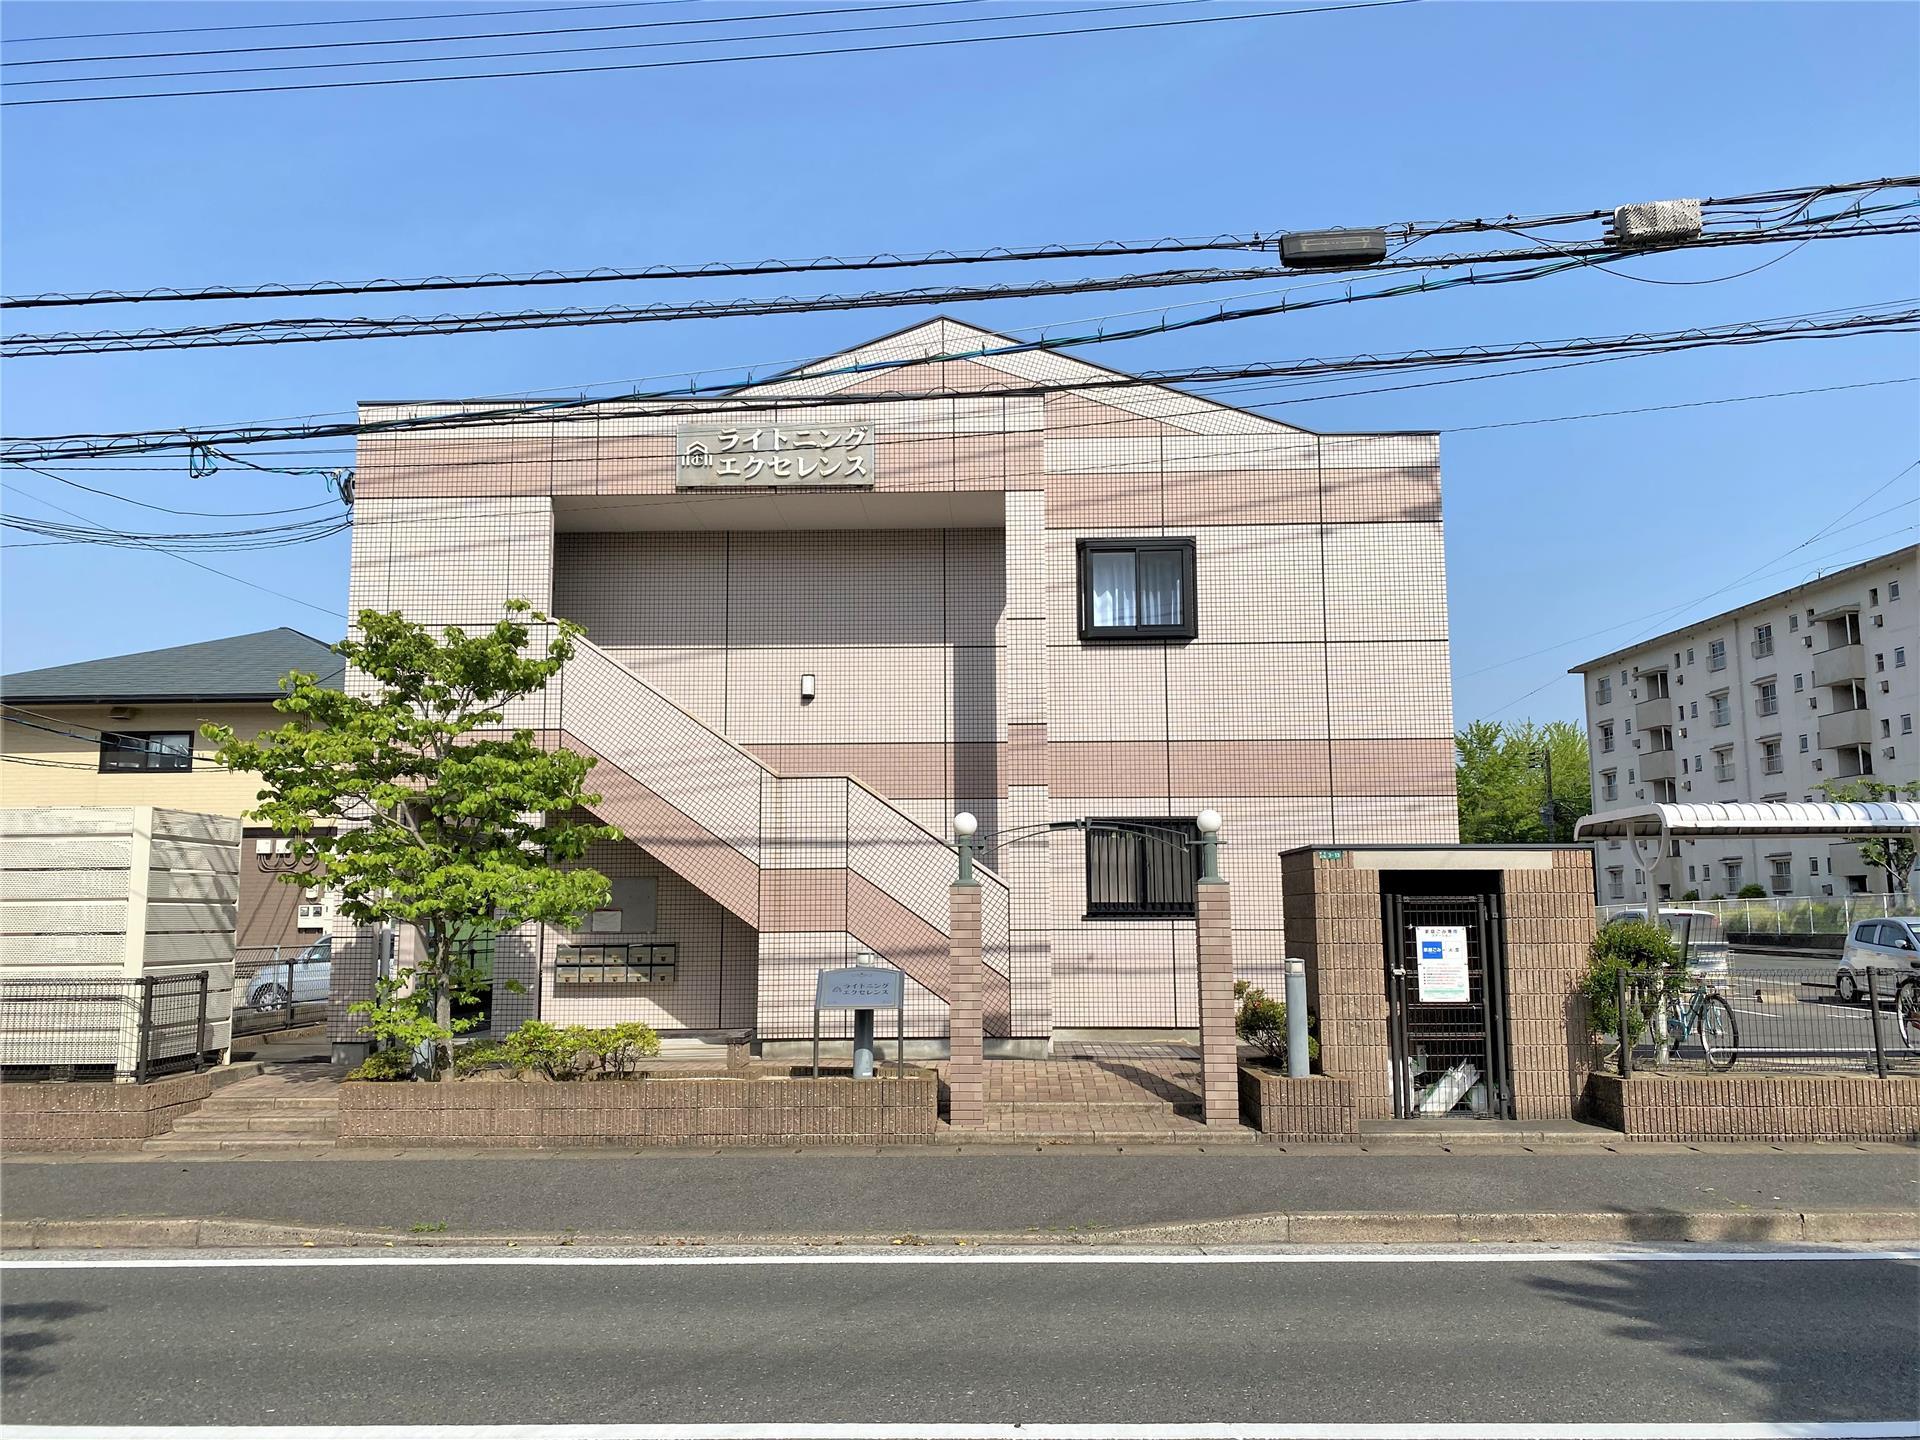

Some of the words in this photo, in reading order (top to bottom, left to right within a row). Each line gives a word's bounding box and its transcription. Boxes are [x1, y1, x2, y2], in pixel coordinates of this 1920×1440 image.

[717, 426, 868, 451] ライトニング
[716, 455, 867, 480] エクセレンス
